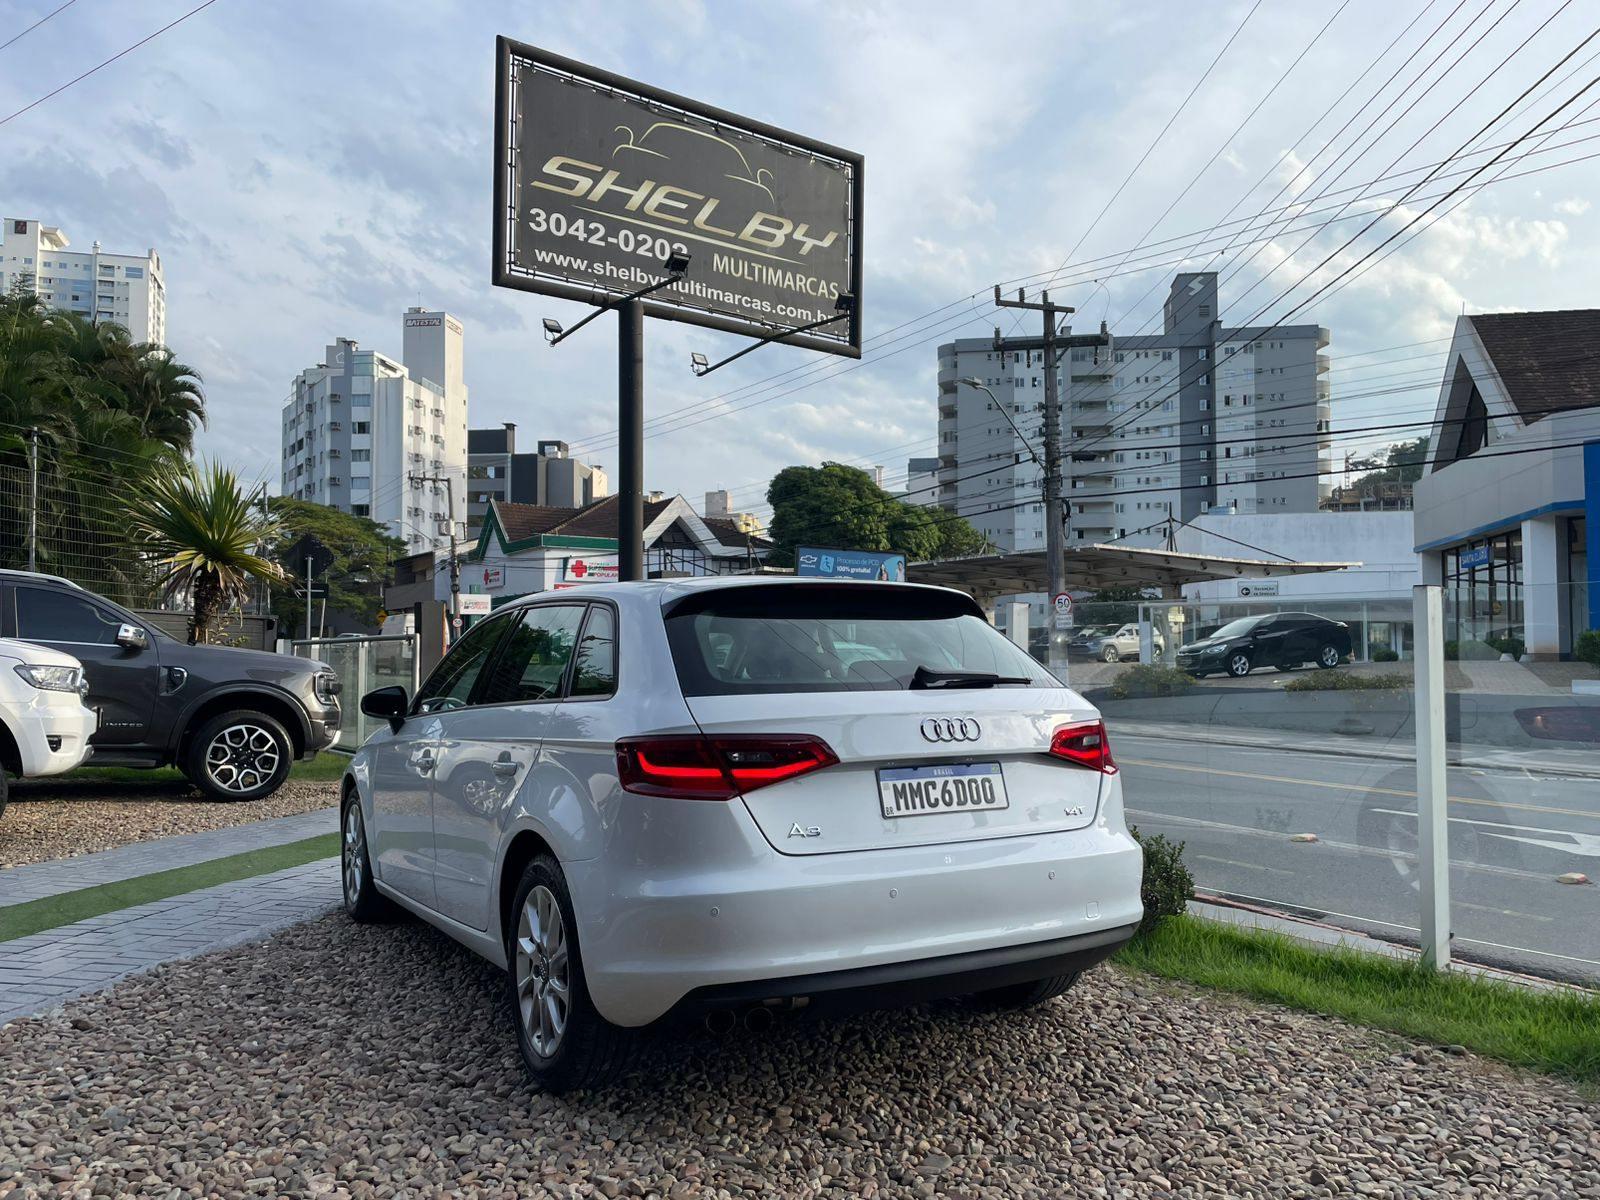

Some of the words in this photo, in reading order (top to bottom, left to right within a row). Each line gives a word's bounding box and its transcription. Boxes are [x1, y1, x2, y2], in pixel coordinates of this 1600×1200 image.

[530, 155, 838, 255] SHELBY
[713, 253, 839, 300] MULTIMARCAS
[1057, 598, 1070, 608] 50
[932, 768, 954, 776] BRASIL
[892, 777, 996, 811] MMC6D00
[886, 806, 895, 816] BR
[787, 822, 822, 839] A3
